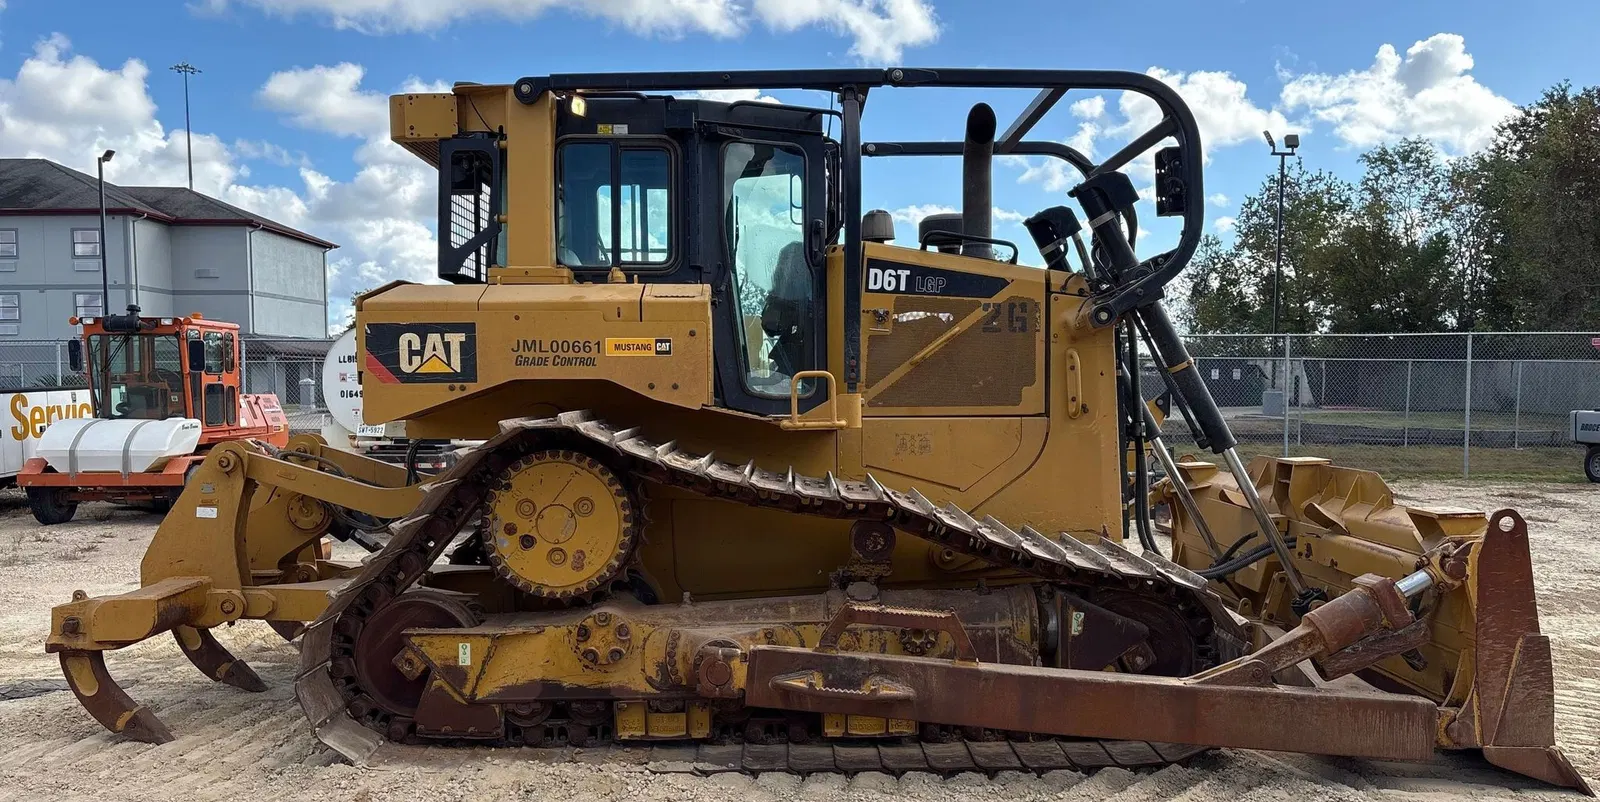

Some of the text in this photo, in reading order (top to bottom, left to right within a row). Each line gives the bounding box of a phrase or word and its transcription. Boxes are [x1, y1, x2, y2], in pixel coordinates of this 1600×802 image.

[868, 268, 946, 293] D6T LGP
[399, 332, 466, 374] CAT
[511, 339, 601, 354] JML00661
[614, 342, 671, 351] MUSTANG CAT
[515, 355, 597, 367] GRADE CONTROL
